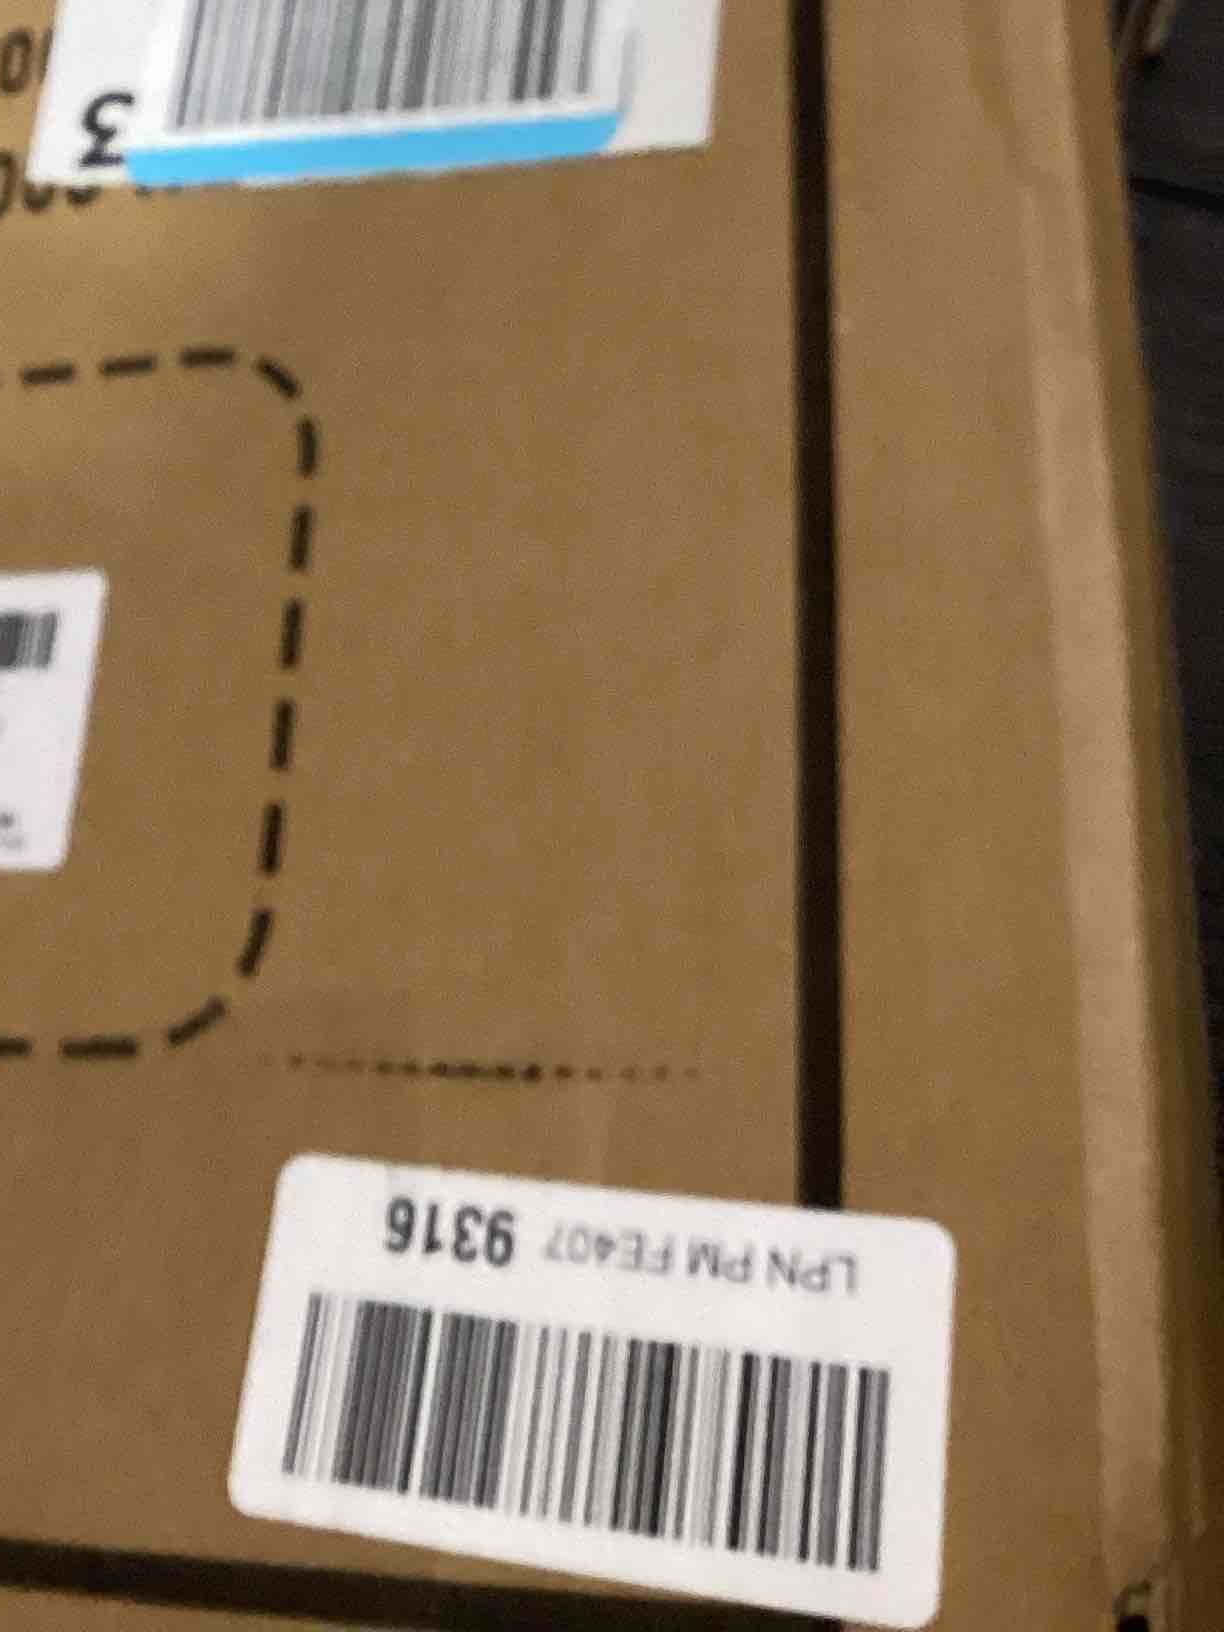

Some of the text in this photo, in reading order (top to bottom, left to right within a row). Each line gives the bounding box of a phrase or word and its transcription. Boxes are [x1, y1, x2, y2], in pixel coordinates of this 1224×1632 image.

[78, 90, 136, 169] 3
[382, 1194, 860, 1298] LPN PM FE407 9316
